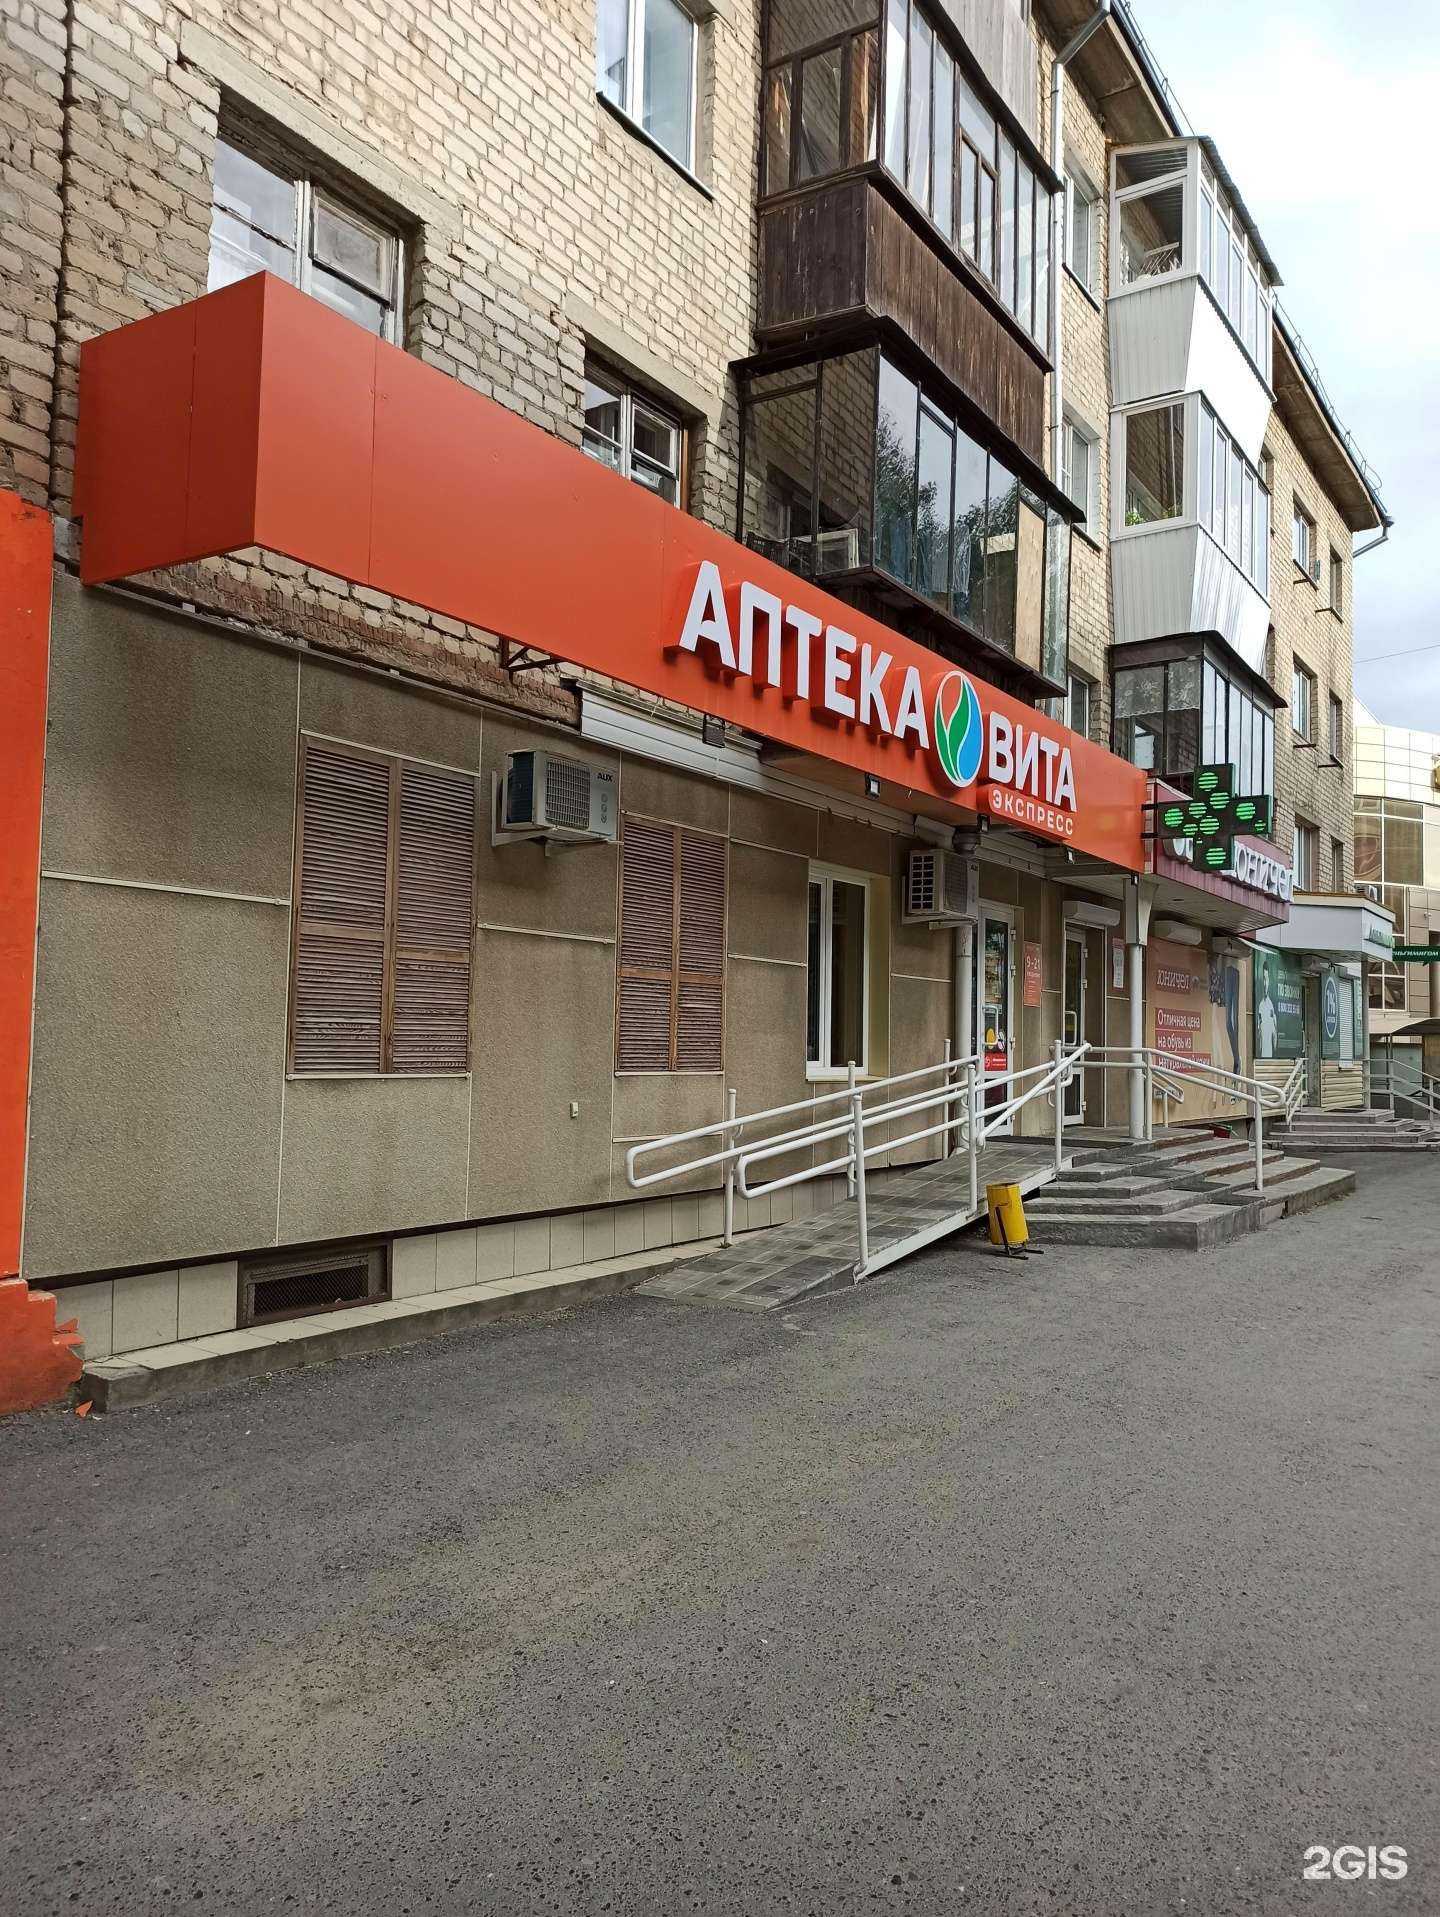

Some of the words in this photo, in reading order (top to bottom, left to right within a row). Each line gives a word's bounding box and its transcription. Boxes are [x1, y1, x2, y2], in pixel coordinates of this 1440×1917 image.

[679, 560, 929, 749] АПТЕКА
[989, 711, 1077, 812] ВИТА
[597, 772, 613, 782] AUX
[993, 789, 1073, 835] ЭКСПРЕСС
[1158, 1009, 1187, 1027] Отличная
[1188, 1015, 1200, 1029] цена
[1158, 1036, 1166, 1048] на
[1167, 1033, 1184, 1051] обувь
